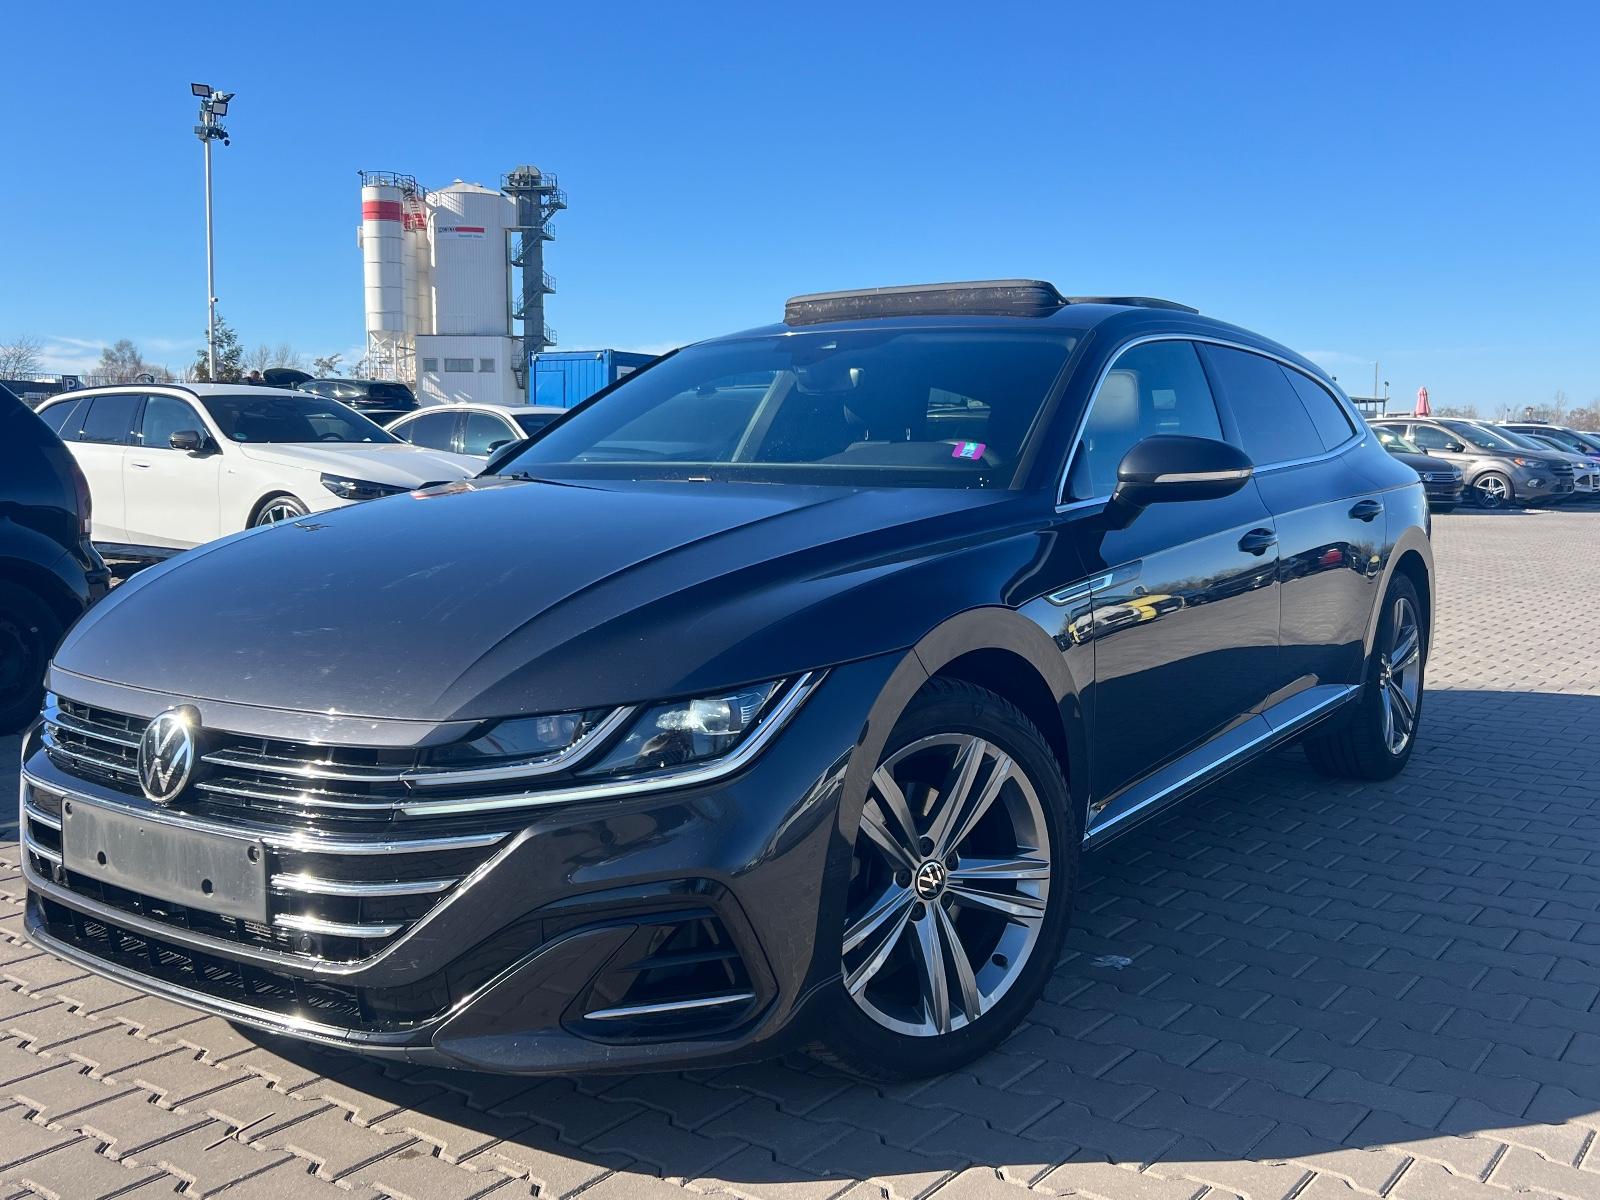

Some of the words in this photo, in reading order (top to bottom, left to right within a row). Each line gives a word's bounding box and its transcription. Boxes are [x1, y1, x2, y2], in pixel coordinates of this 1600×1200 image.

[65, 379, 76, 392] P
[140, 713, 191, 800] VW
[917, 861, 945, 899] VW
